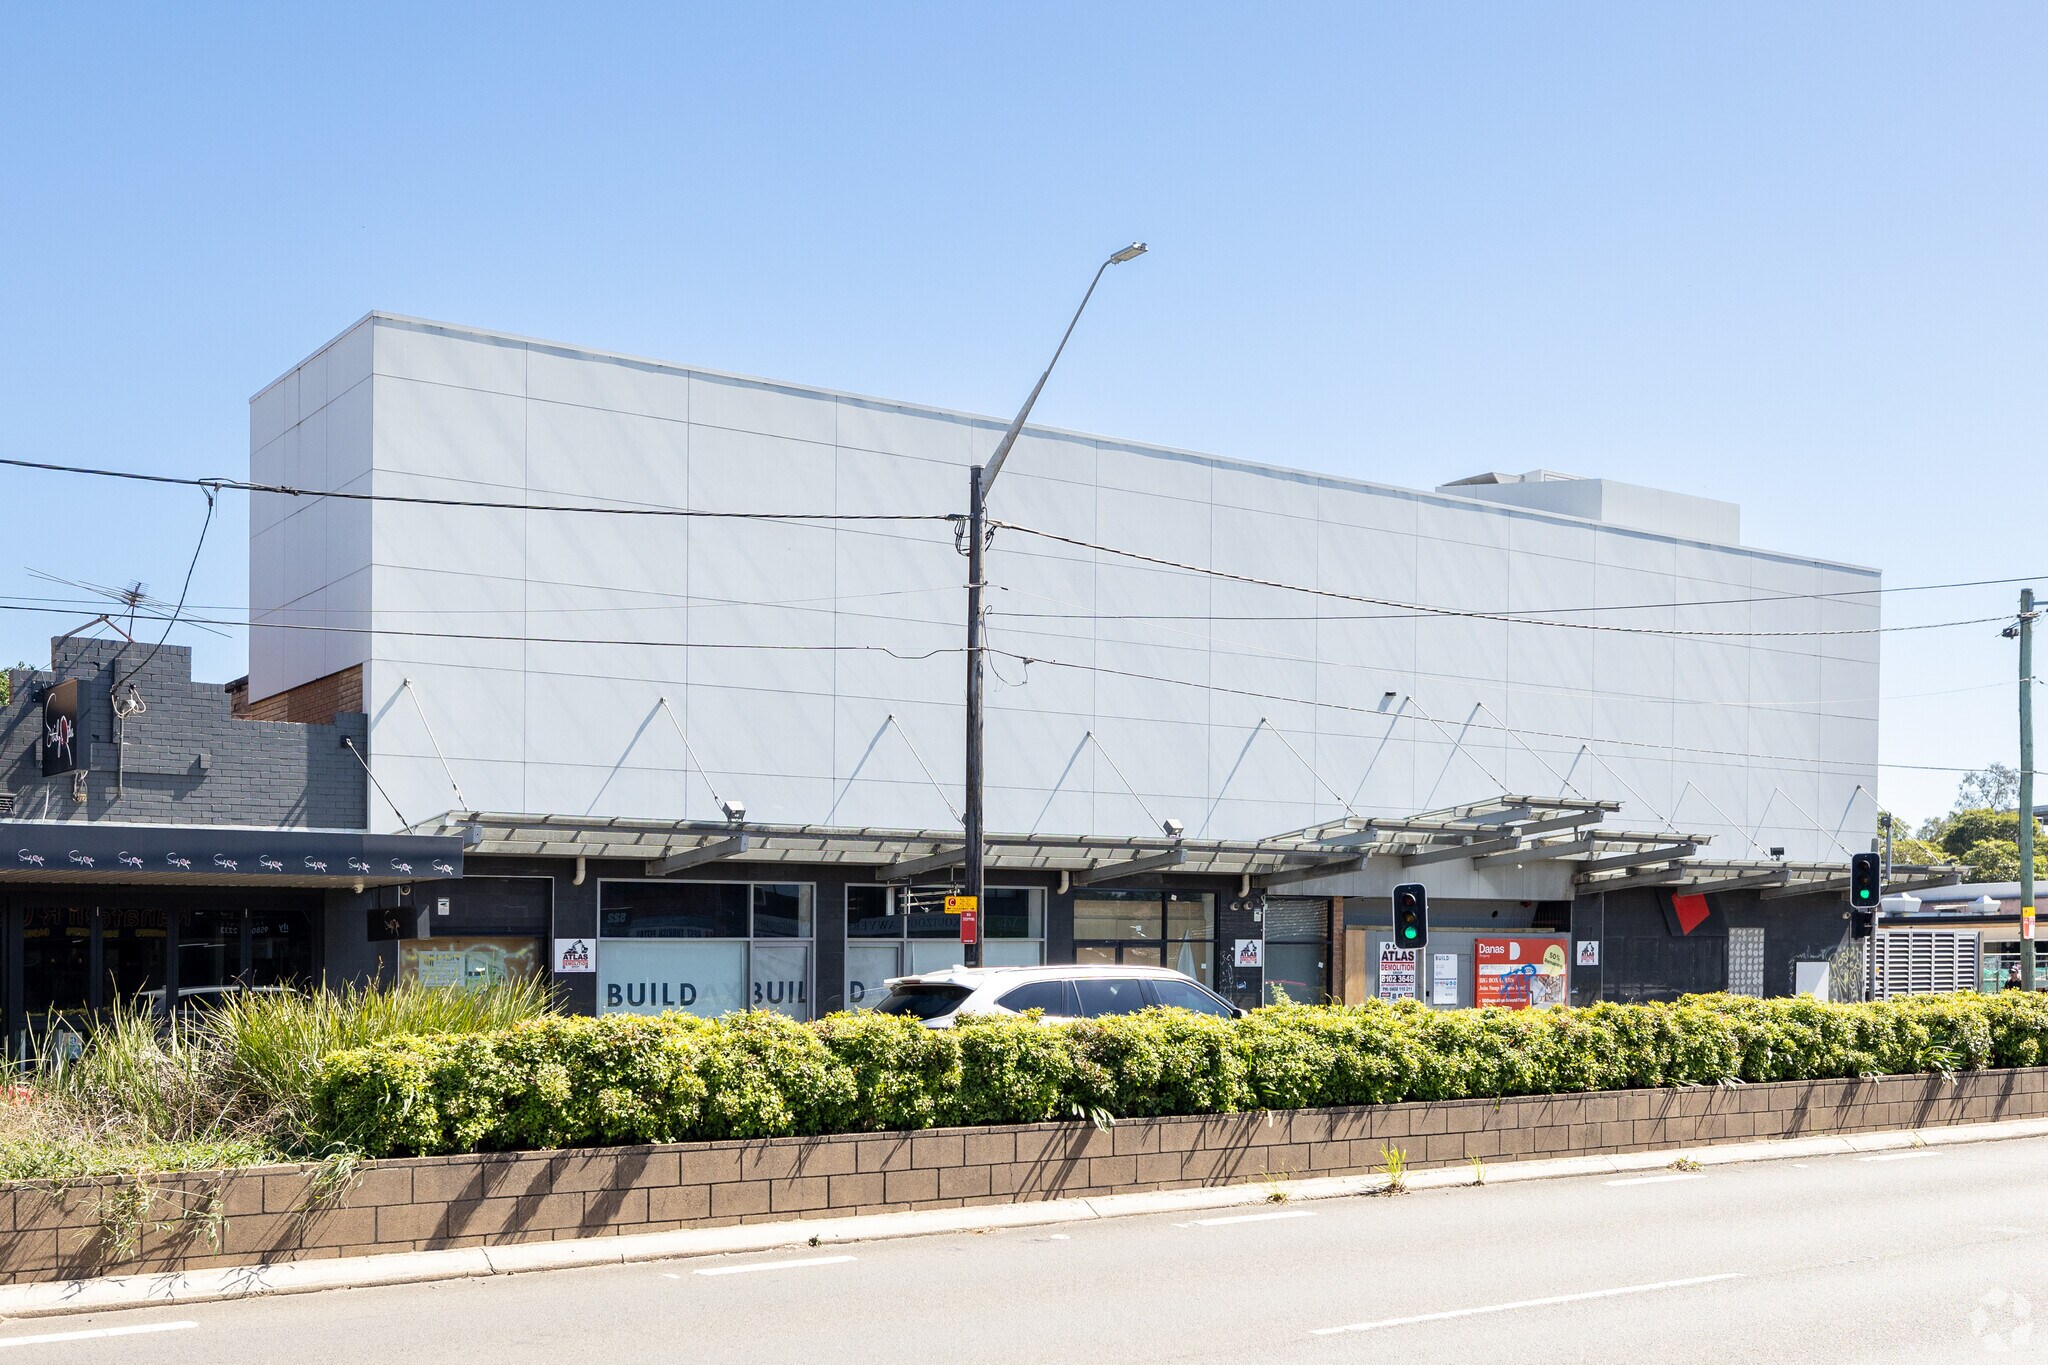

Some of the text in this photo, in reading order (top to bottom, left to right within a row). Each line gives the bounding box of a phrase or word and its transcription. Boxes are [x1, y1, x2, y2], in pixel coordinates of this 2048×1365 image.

[1479, 943, 1505, 954] Danas
[1380, 950, 1415, 961] ATLAS
[1381, 963, 1414, 971] DEMOLITION
[1381, 975, 1396, 983] 8102
